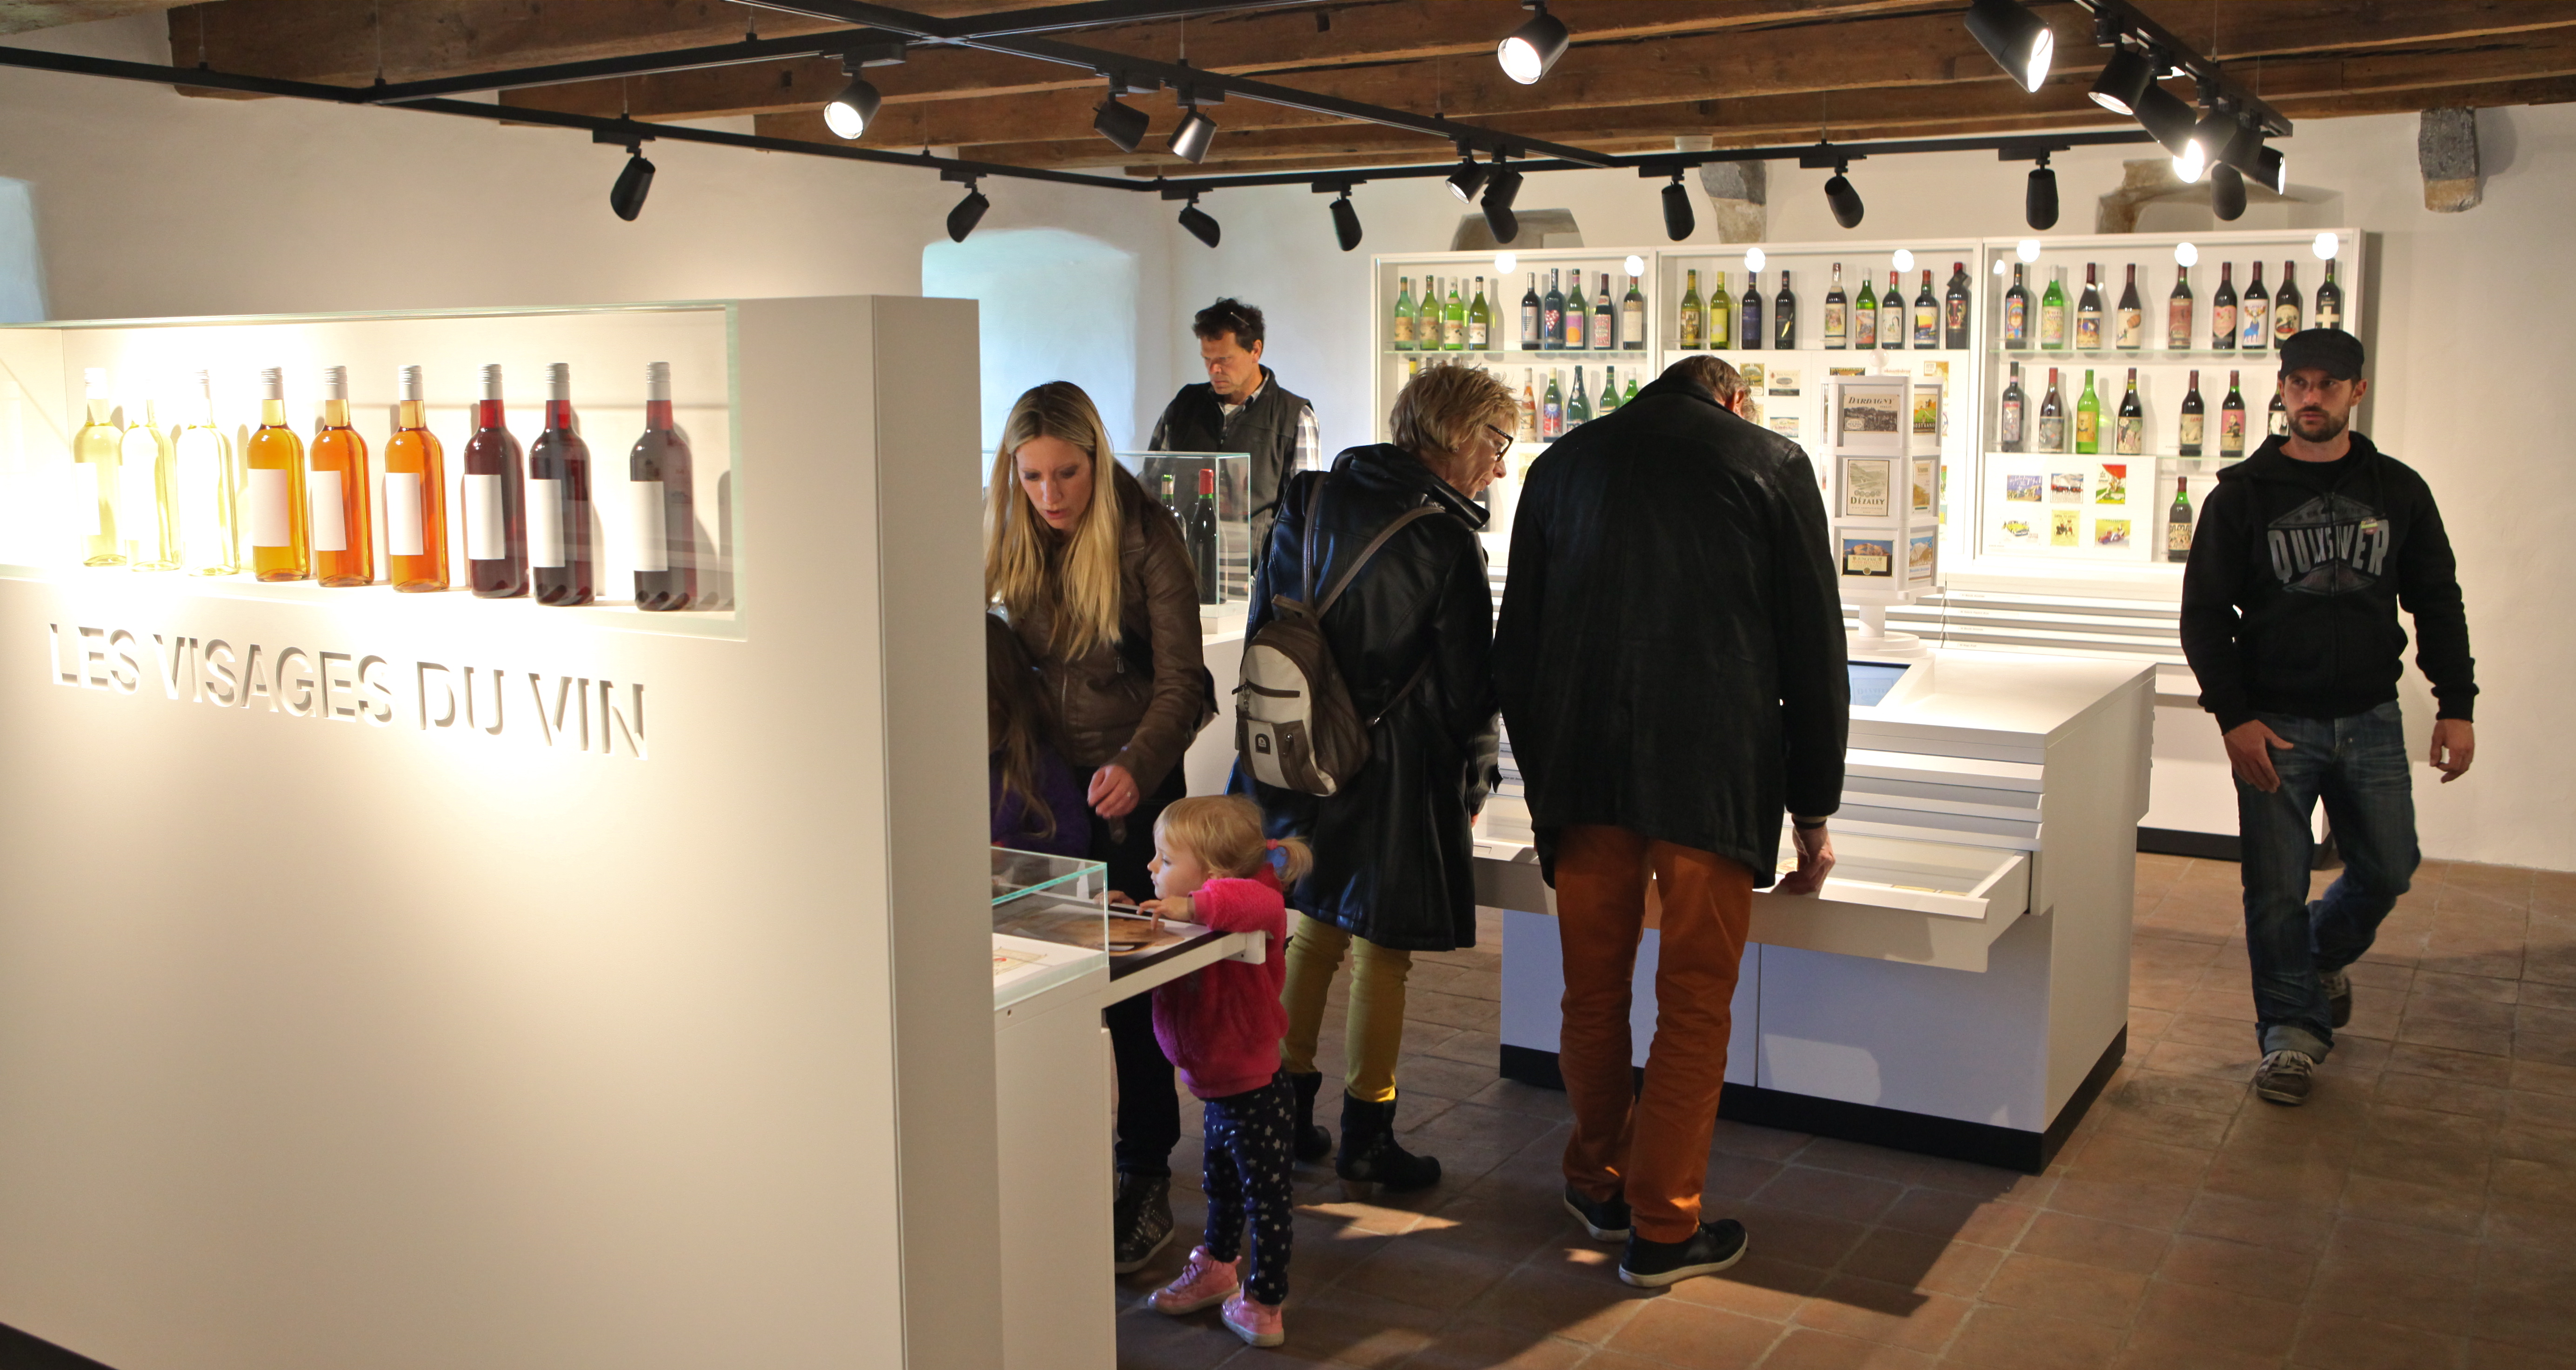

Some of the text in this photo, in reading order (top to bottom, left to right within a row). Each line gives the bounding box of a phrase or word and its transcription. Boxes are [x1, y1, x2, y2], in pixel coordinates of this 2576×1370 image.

[1849, 396, 1894, 405] DARDAGNY
[1850, 496, 1885, 505] DÉZALEY
[49, 623, 649, 761] LES VISAGES DU VIN
